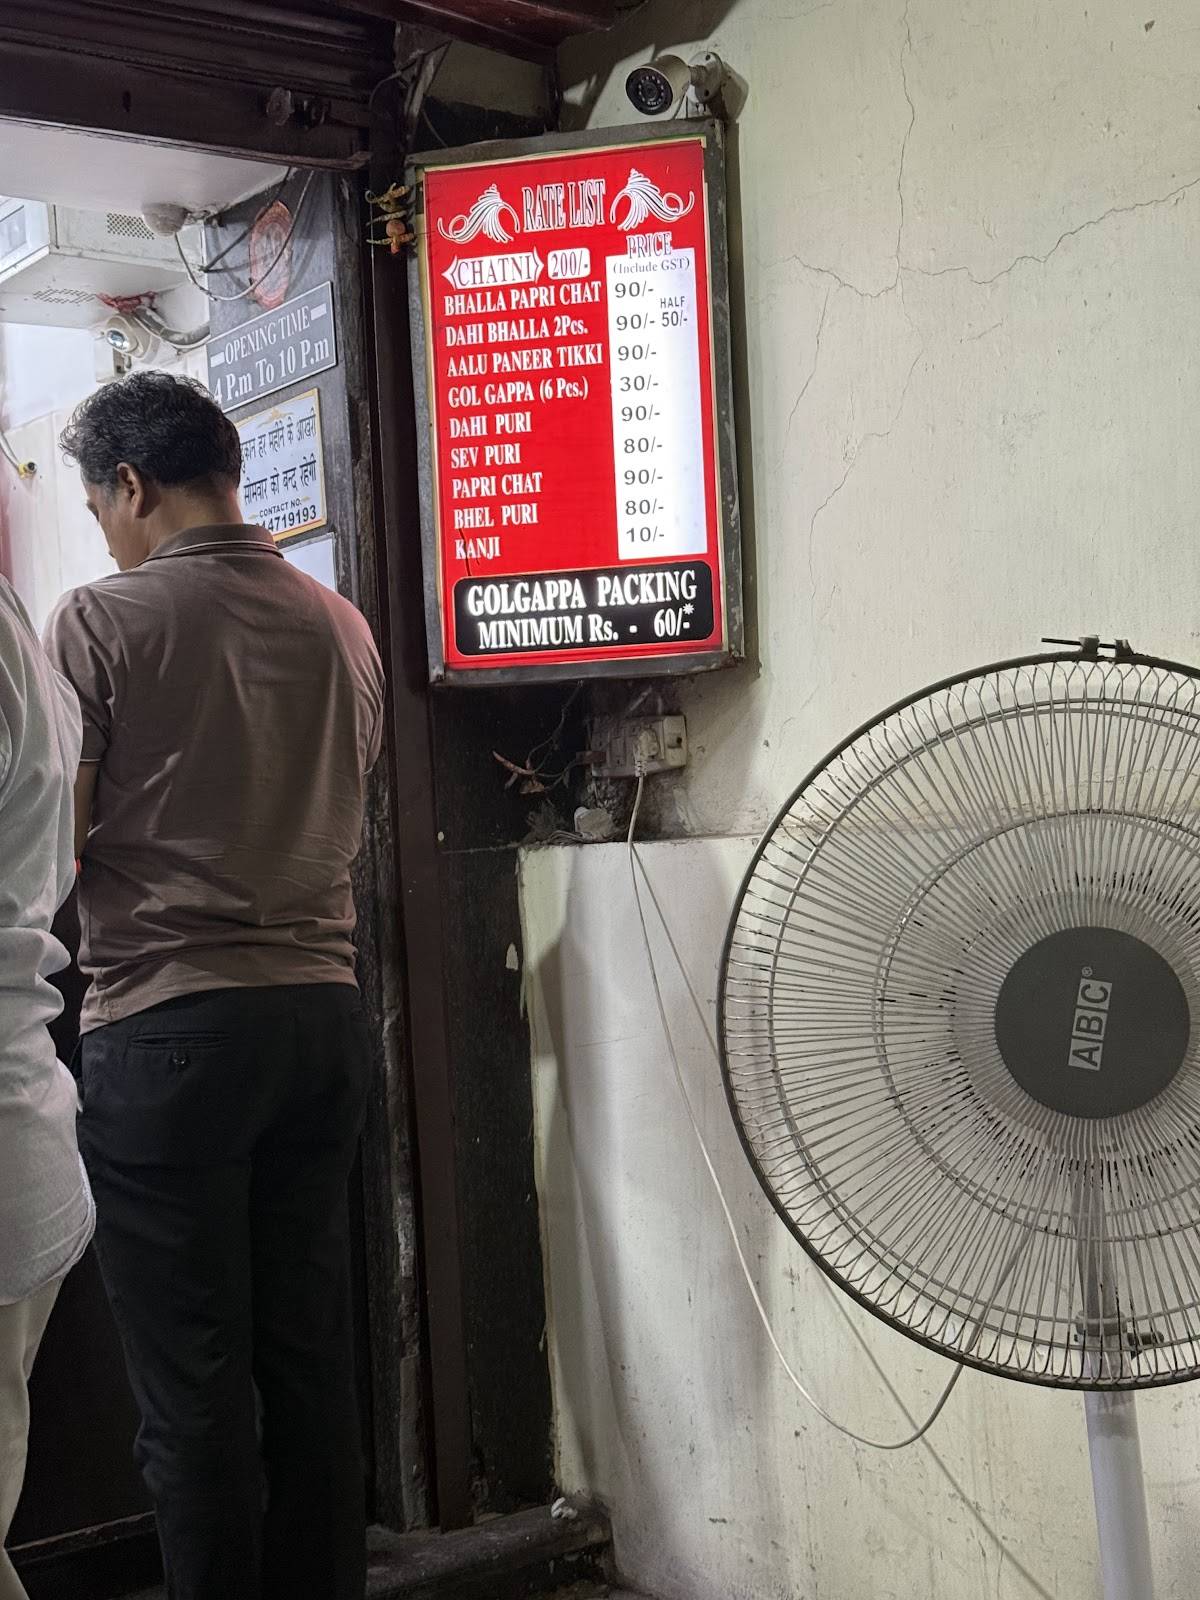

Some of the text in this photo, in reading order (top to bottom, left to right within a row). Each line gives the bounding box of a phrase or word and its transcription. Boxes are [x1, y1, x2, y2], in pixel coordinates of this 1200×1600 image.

[522, 179, 605, 232] RATE LIST
[627, 232, 672, 258] PRICE
[457, 252, 589, 286] CHATNI 200/-
[613, 256, 690, 274] (Include GST)
[444, 281, 601, 316] BHALLA PAPRI CHAT
[615, 281, 654, 298] 90/-
[660, 296, 686, 309] HALF
[446, 317, 588, 346] DAHI BHALLA 2Pcs.
[616, 311, 688, 331] 90/- 50/-
[225, 306, 310, 364] OPENING TIME
[448, 343, 603, 377] AALU PANEER TIKKI
[617, 343, 657, 361] 90/-
[214, 338, 329, 404] 4 P.m To 10 P.m
[619, 374, 659, 392] 30/-
[448, 376, 589, 408] GOL GAPPA (6 Pcs.)
[450, 412, 532, 438] DAHI PURI
[621, 405, 661, 422] 90/-
[258, 434, 266, 457] हर
[268, 420, 284, 452] महीने
[287, 416, 293, 444] के
[623, 436, 663, 454] 80/-
[451, 443, 521, 469] SEV PURI
[244, 477, 268, 505] सोमवार
[270, 467, 279, 495] को
[452, 472, 543, 499] PAPRI CHAT
[624, 468, 663, 486] 90/-
[260, 498, 301, 517] CONTACT NO.
[454, 503, 538, 529] BHEL PURI
[625, 498, 664, 516] 80/-
[626, 526, 665, 543] 10/-
[455, 536, 500, 560] KANJI
[467, 569, 697, 617] GOLGAPPA PACKING
[478, 615, 583, 650] MINIMUM
[588, 614, 619, 642] Rs.
